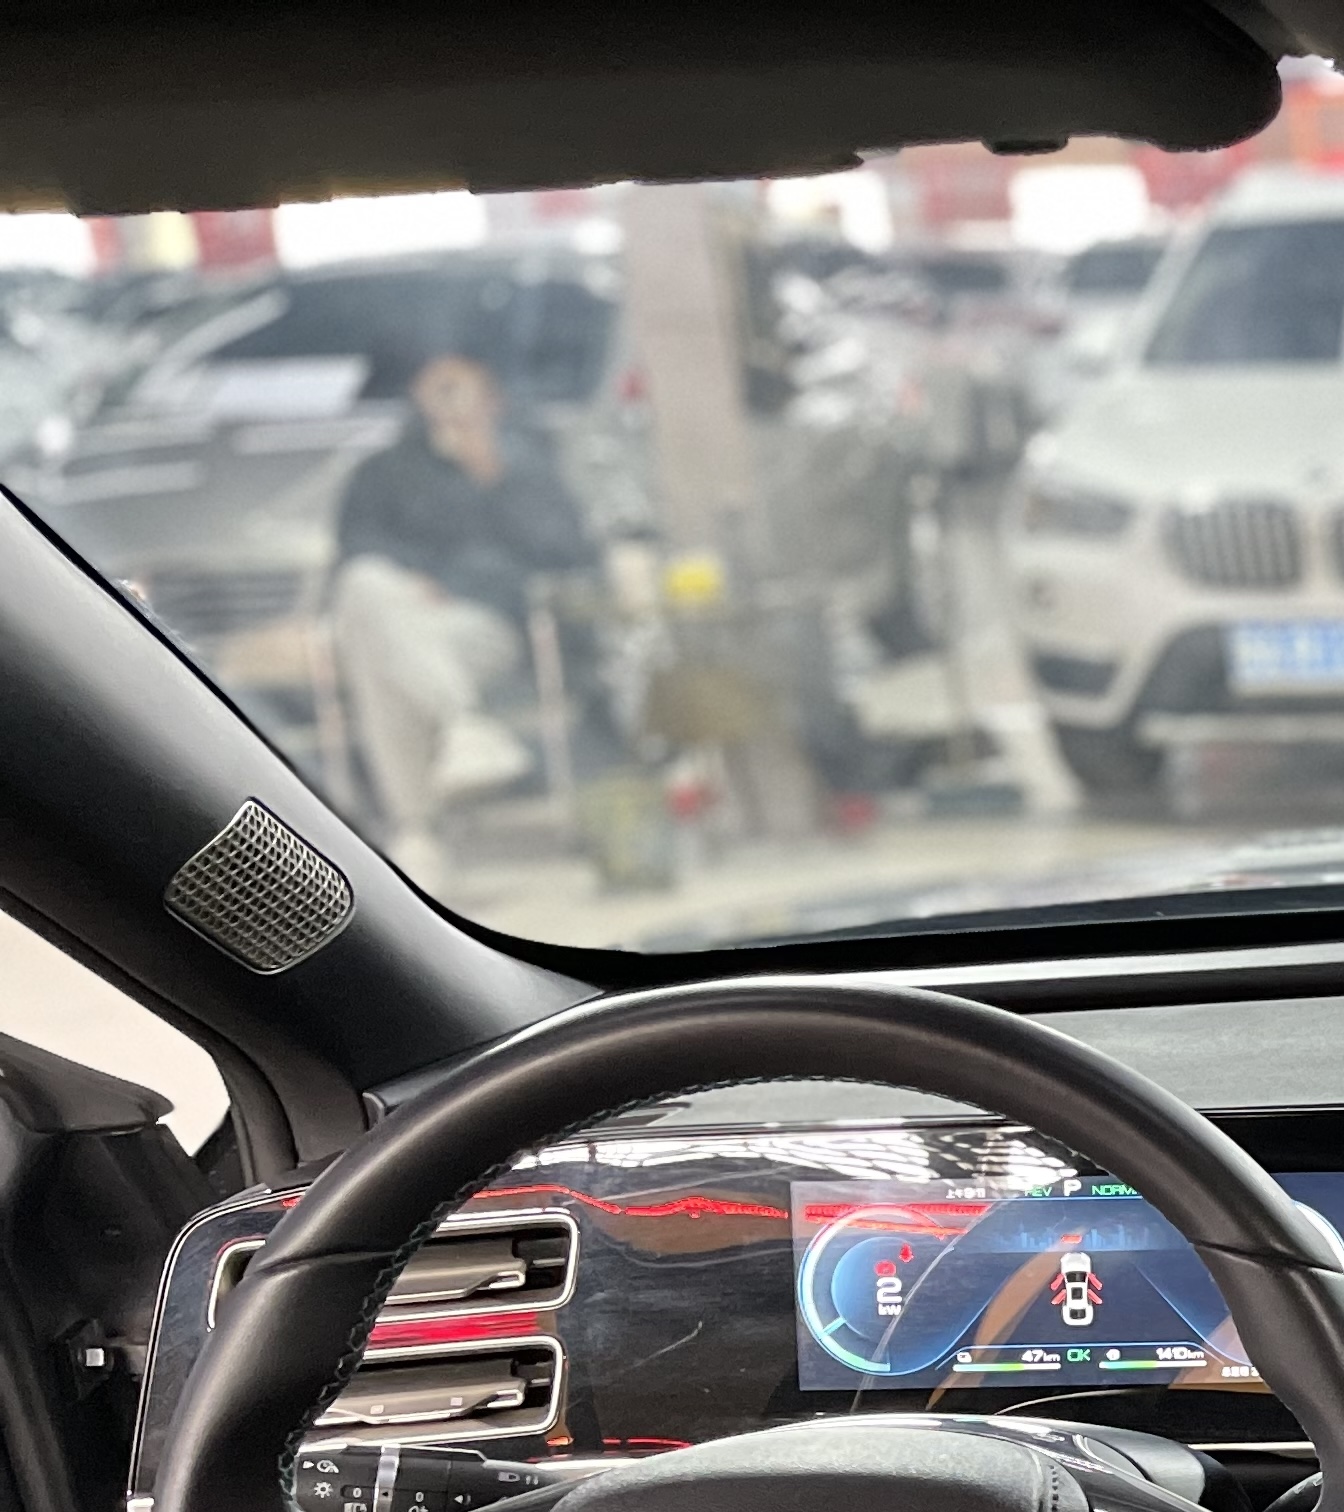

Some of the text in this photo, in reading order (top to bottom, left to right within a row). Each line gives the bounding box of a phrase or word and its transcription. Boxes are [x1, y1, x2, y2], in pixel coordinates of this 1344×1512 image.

[1063, 1179, 1082, 1197] P
[1091, 1184, 1138, 1196] NORM
[876, 1276, 903, 1304] 2
[1066, 1348, 1091, 1362] OK
